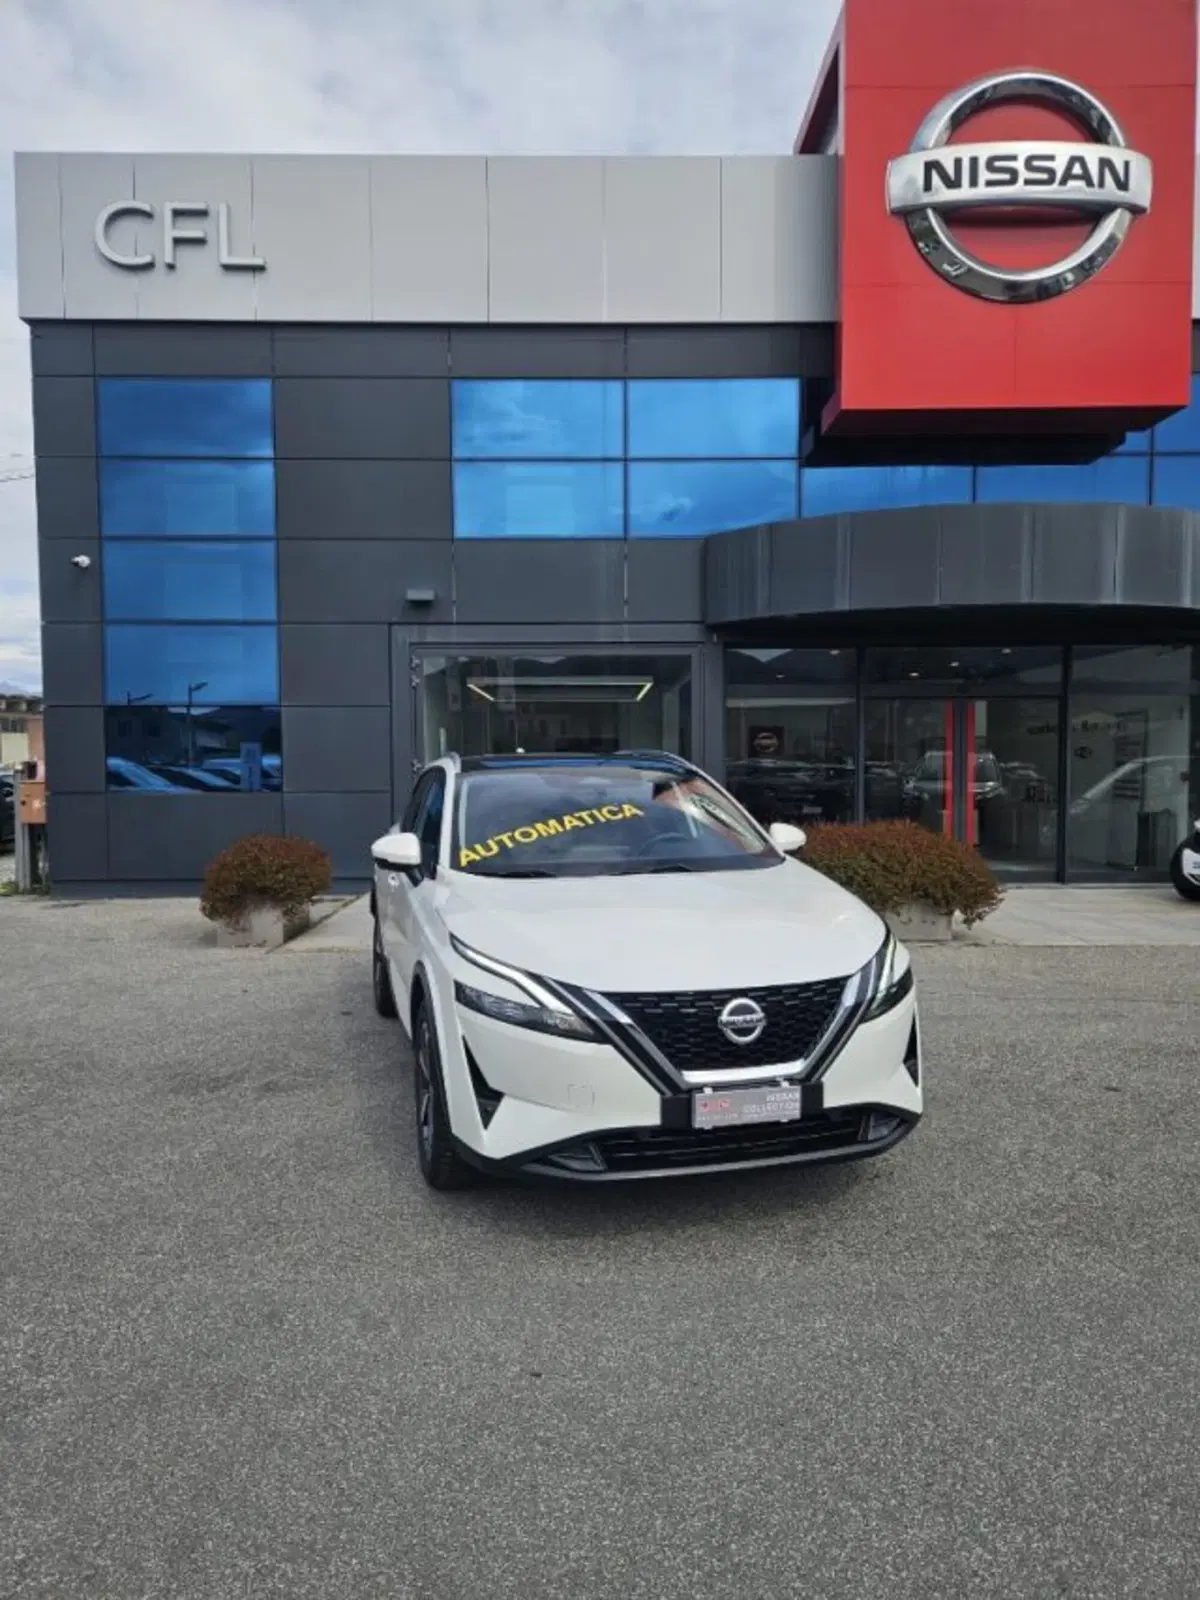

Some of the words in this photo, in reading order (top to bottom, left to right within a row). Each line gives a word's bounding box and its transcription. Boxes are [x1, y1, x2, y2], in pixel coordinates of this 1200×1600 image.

[923, 154, 1131, 193] NISSAN
[95, 200, 267, 272] CFL
[458, 801, 645, 867] AUTOMATICA
